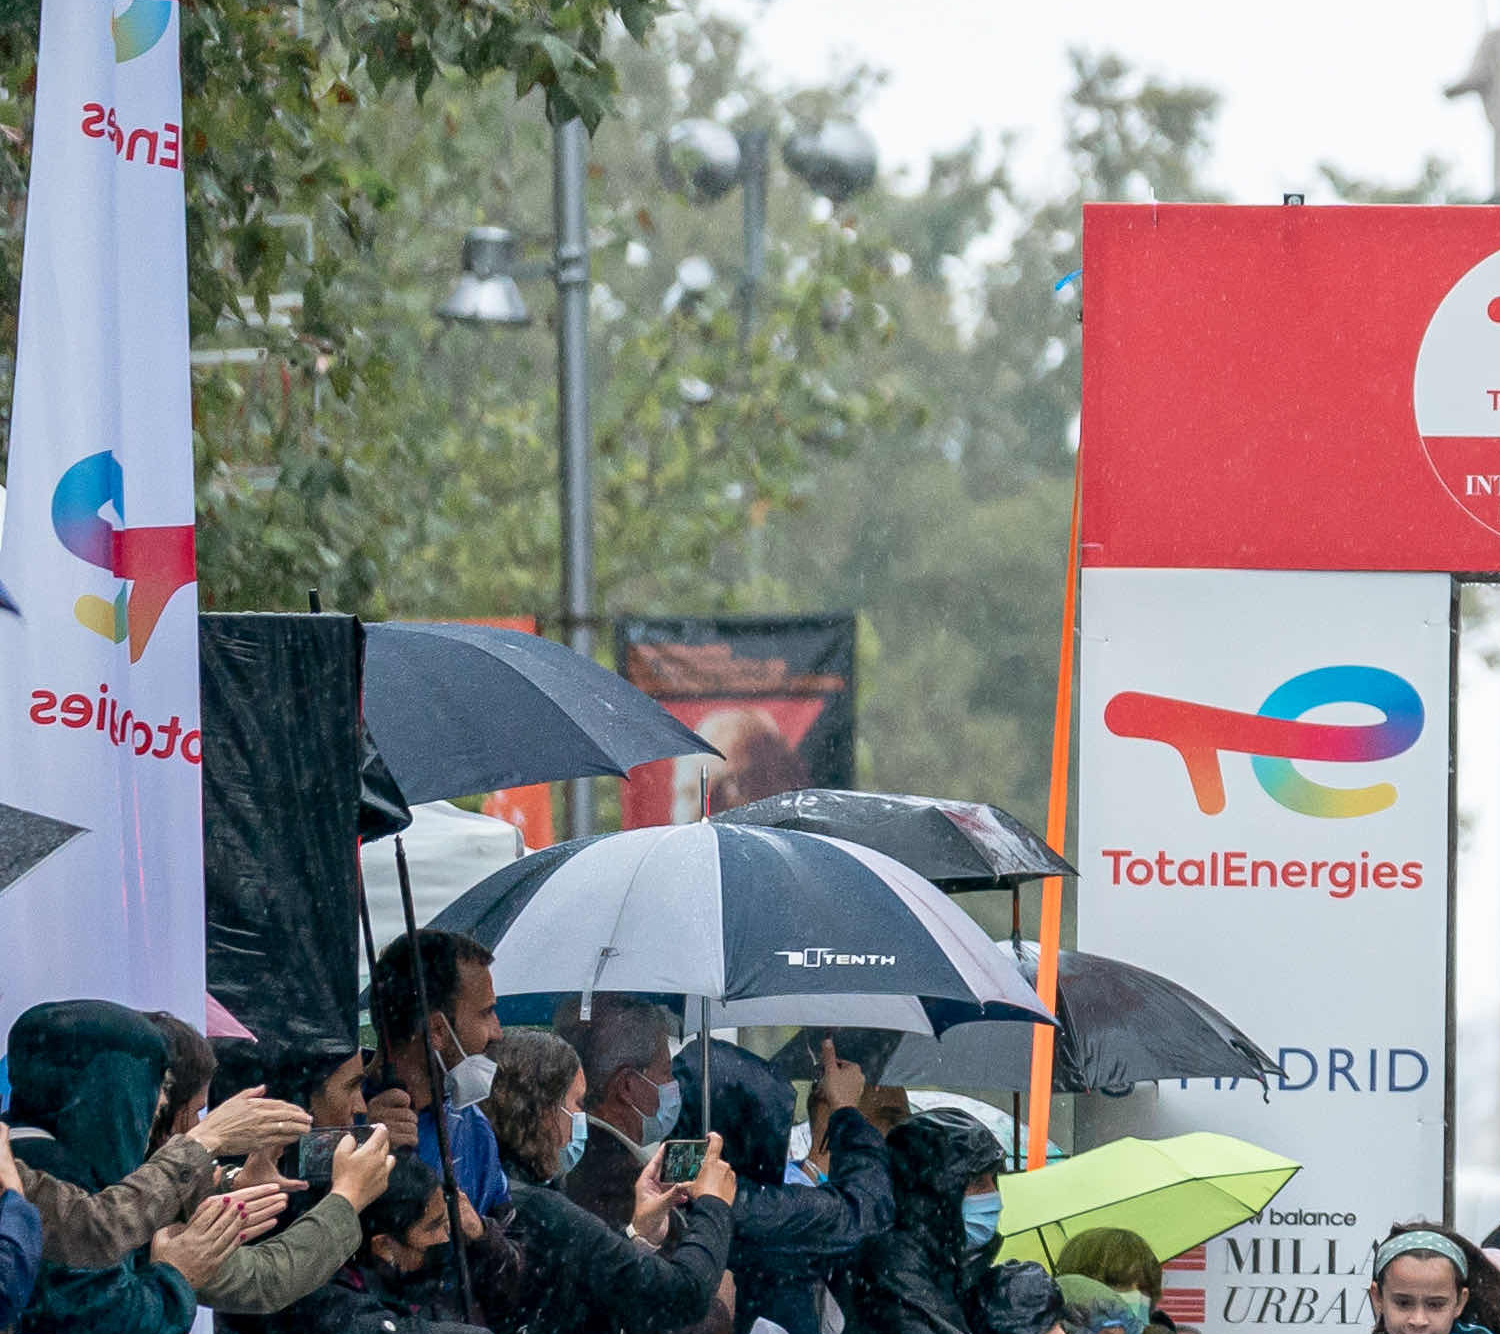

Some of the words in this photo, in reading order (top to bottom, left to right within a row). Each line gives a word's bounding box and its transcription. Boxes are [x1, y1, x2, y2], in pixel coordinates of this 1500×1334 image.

[1102, 849, 1423, 899] TotalEnergies
[823, 954, 896, 966] TENTH
[1269, 1208, 1357, 1227] balance
